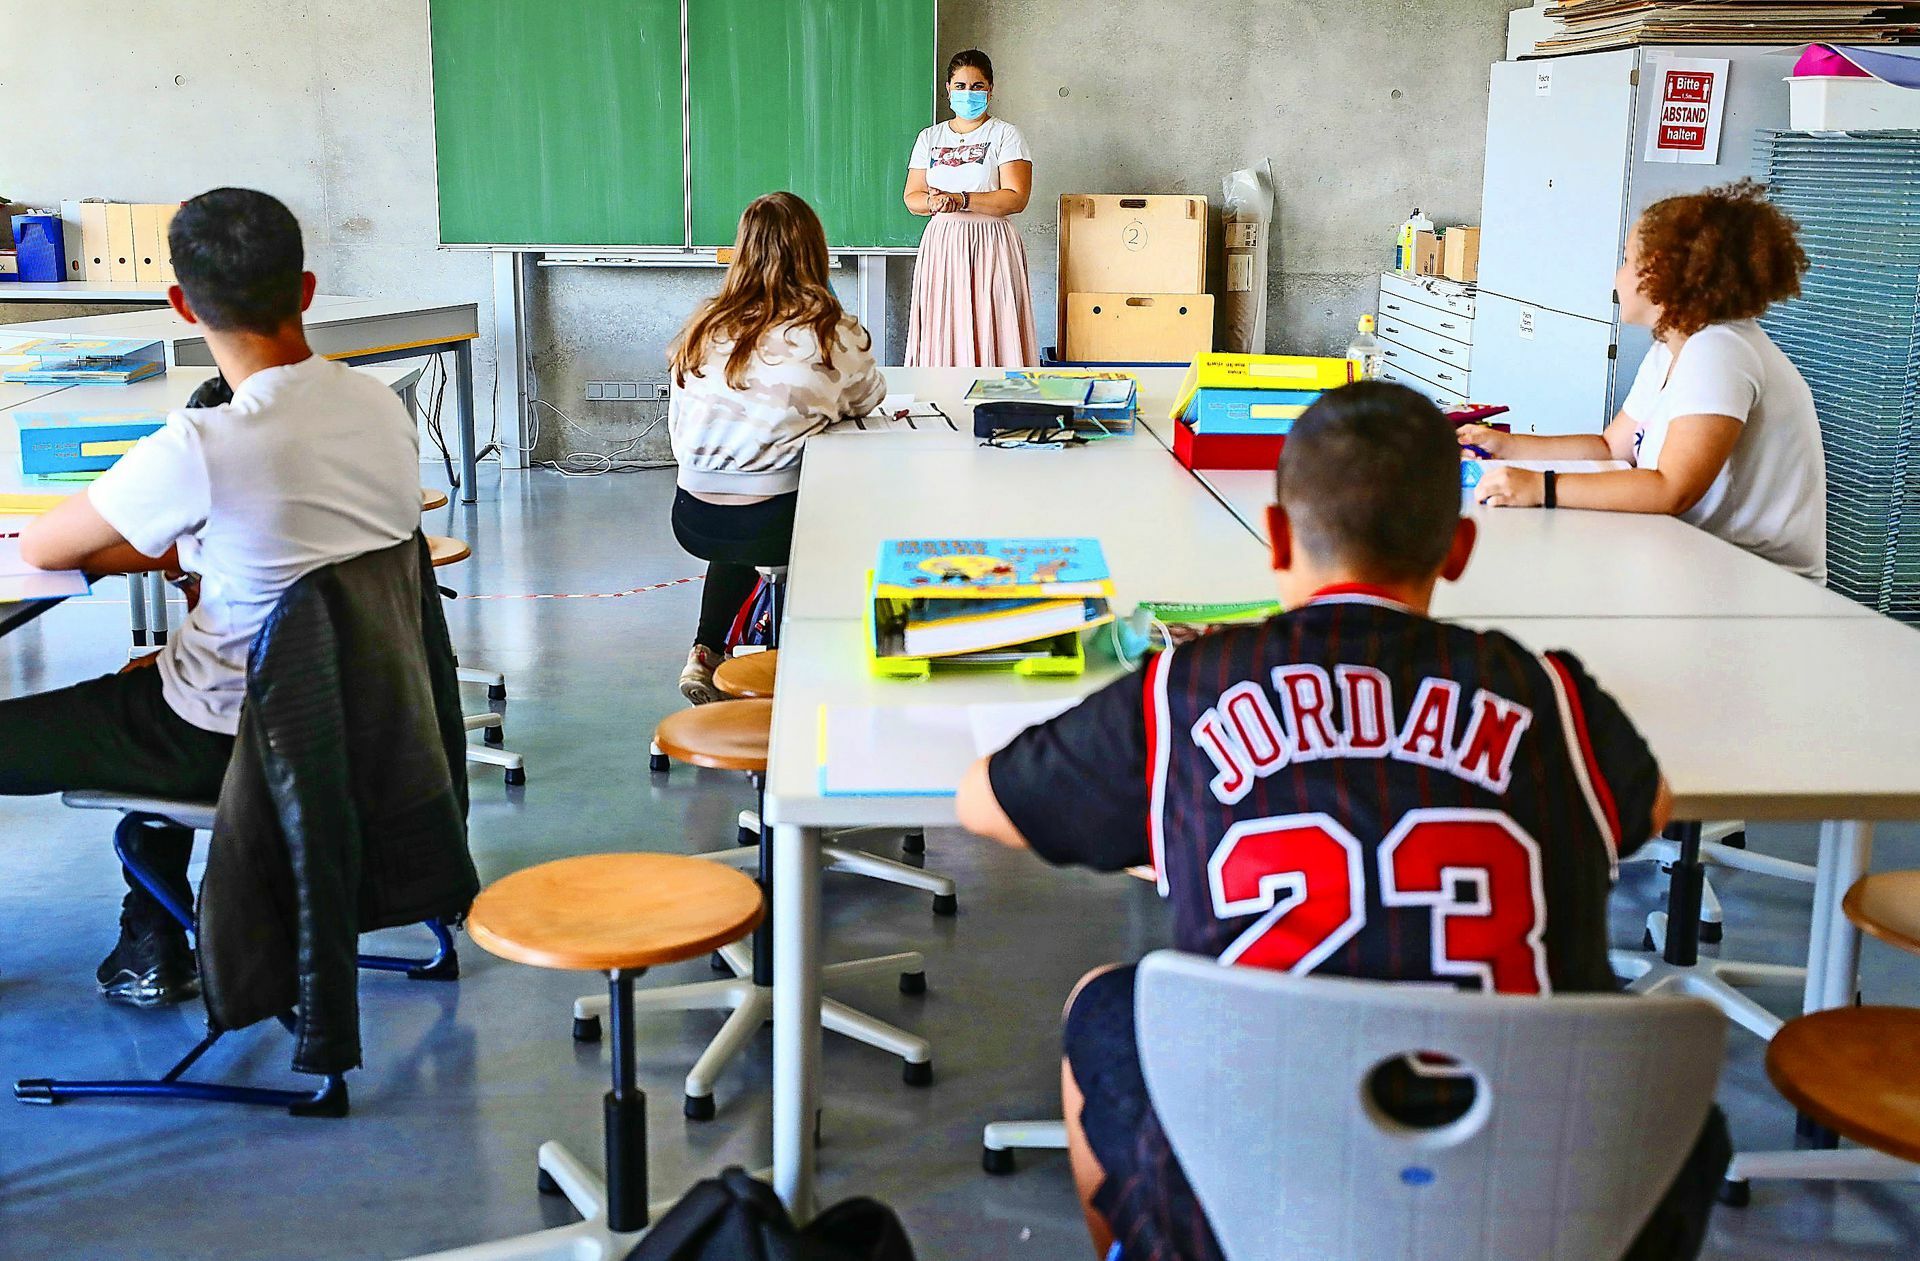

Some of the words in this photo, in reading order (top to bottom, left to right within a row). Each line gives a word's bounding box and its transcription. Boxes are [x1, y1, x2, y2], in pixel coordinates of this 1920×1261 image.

[1676, 77, 1700, 90] Bitte
[1662, 106, 1706, 123] ABSTAND
[1666, 127, 1697, 141] halten
[1128, 228, 1139, 245] 2
[1190, 663, 1532, 805] JORDAN
[1207, 807, 1552, 998] 23
